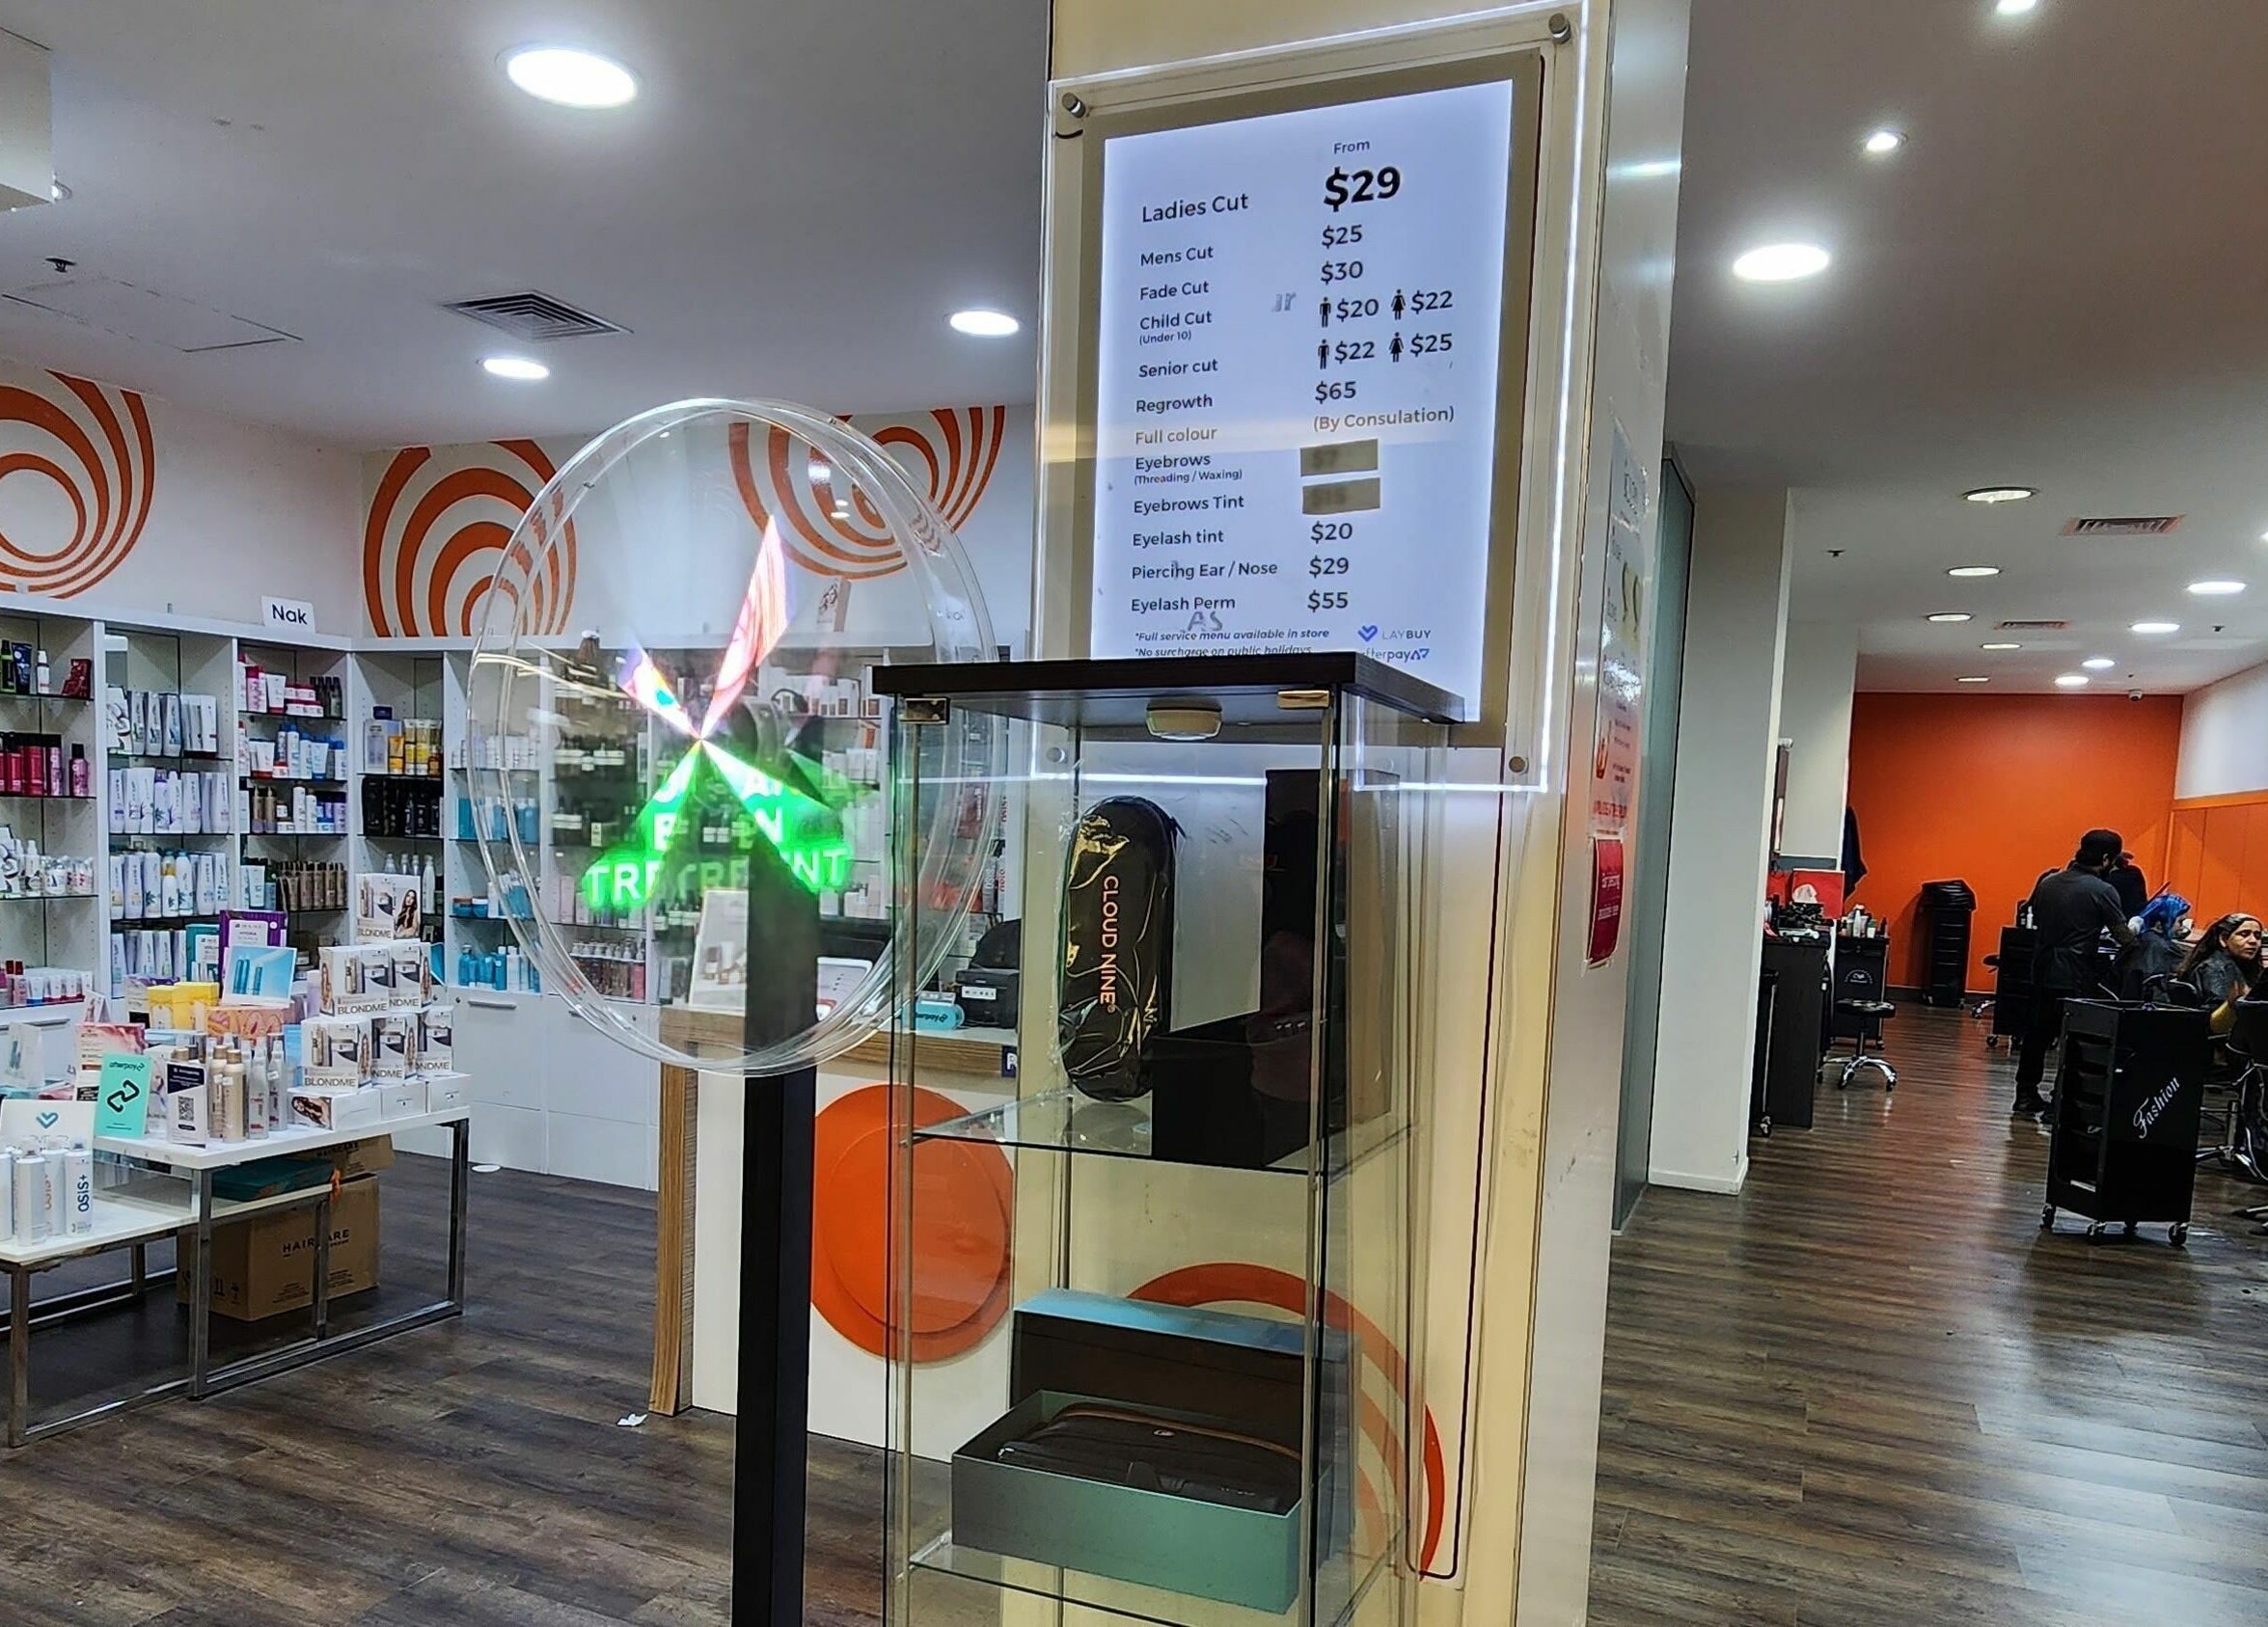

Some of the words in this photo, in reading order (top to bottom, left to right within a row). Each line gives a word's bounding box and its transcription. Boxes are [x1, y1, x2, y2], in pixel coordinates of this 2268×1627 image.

[1333, 140, 1371, 155] From
[1323, 166, 1402, 213] $29
[1142, 199, 1207, 223] Ladies
[1212, 193, 1249, 214] Cut
[1321, 224, 1363, 249] $25
[1140, 252, 1182, 267] Mens
[1186, 245, 1214, 262] Cut
[1320, 260, 1364, 285] $30
[1139, 284, 1178, 301] Fade
[1181, 281, 1210, 296] Cut
[1410, 289, 1453, 313] $22
[1335, 298, 1380, 321] $20
[1139, 312, 1181, 331] Child
[1185, 310, 1213, 326] Cut
[1138, 332, 1175, 346] (Under
[1176, 330, 1192, 342] 10)
[1409, 332, 1453, 357] $25
[1334, 339, 1376, 364] $22
[1138, 361, 1189, 378] Senior
[1191, 358, 1218, 373] cut
[1314, 380, 1357, 404] $65
[1135, 393, 1213, 415] Regrowth
[1313, 414, 1341, 433] (By
[1344, 405, 1455, 429] Consulation)
[1135, 429, 1164, 446] Full
[1167, 426, 1217, 443] colour
[1135, 454, 1212, 473] Eyebrows
[1134, 473, 1190, 486] (Threading
[1198, 469, 1243, 481] Waxing)
[1134, 499, 1209, 516] Eyebrows
[1213, 495, 1244, 510] Tint
[1133, 530, 1192, 549] Eyelash
[1196, 529, 1224, 544] tint
[1310, 520, 1353, 544] $20
[1132, 563, 1195, 581] Piercing
[1199, 563, 1225, 578] Ear
[1238, 562, 1278, 576] Nose
[1308, 556, 1350, 579] $29
[1131, 596, 1189, 614] Eyelash
[1193, 595, 1236, 610] Perm
[1306, 589, 1349, 613] $55
[271, 604, 308, 625] Nak
[1160, 632, 1197, 641] service
[1233, 630, 1285, 639] available
[1287, 628, 1298, 638] in
[1300, 630, 1329, 638] store
[1381, 630, 1432, 640] LAYBUY
[1365, 647, 1410, 663] fterpay
[1101, 875, 1119, 947] CLOUD
[1100, 953, 1117, 1005] NINE
[338, 1002, 388, 1014] BLONDME
[389, 998, 420, 1008] NDME
[371, 1069, 403, 1078] NDME
[415, 1062, 451, 1071] NDME
[304, 1077, 356, 1087] BLONDME
[2132, 1076, 2180, 1139] Fashion
[282, 1229, 350, 1253] HAIRARE
